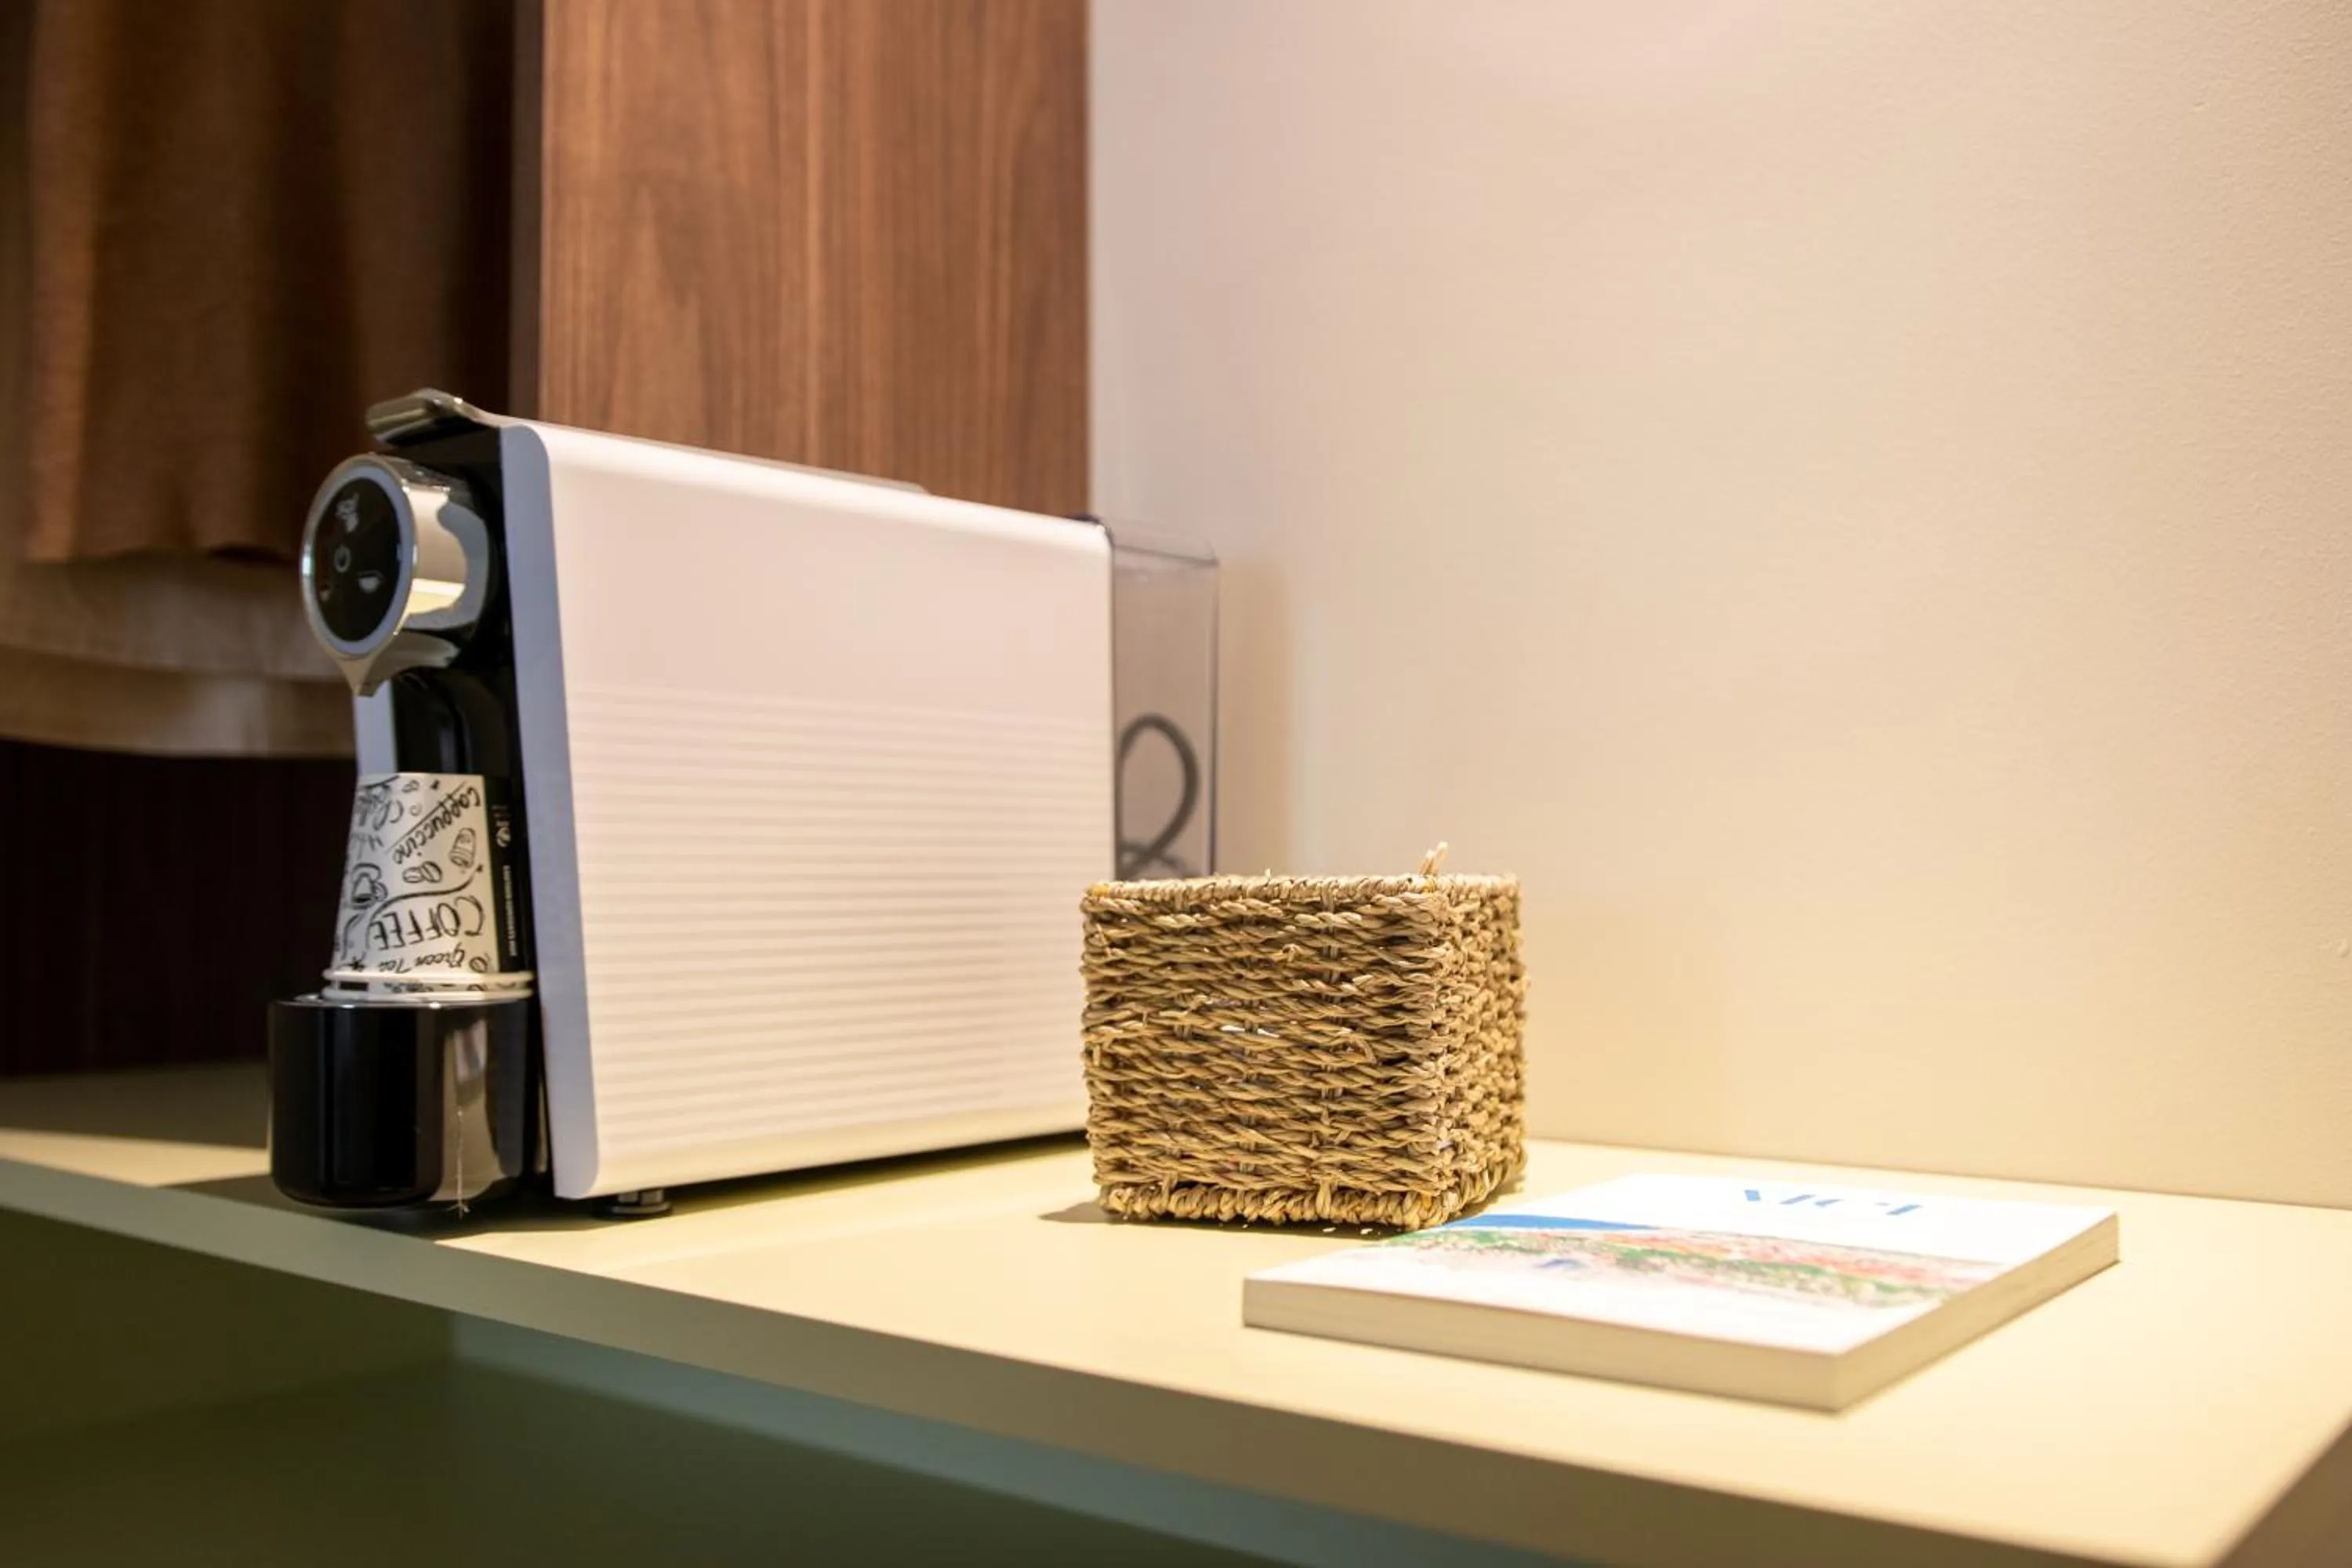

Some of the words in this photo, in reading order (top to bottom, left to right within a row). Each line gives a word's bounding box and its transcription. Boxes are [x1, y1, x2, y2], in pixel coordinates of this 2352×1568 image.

[393, 786, 481, 865] Cappuccino
[371, 895, 485, 951] COFFEE
[378, 958, 411, 975] Tea
[415, 942, 466, 969] Green
